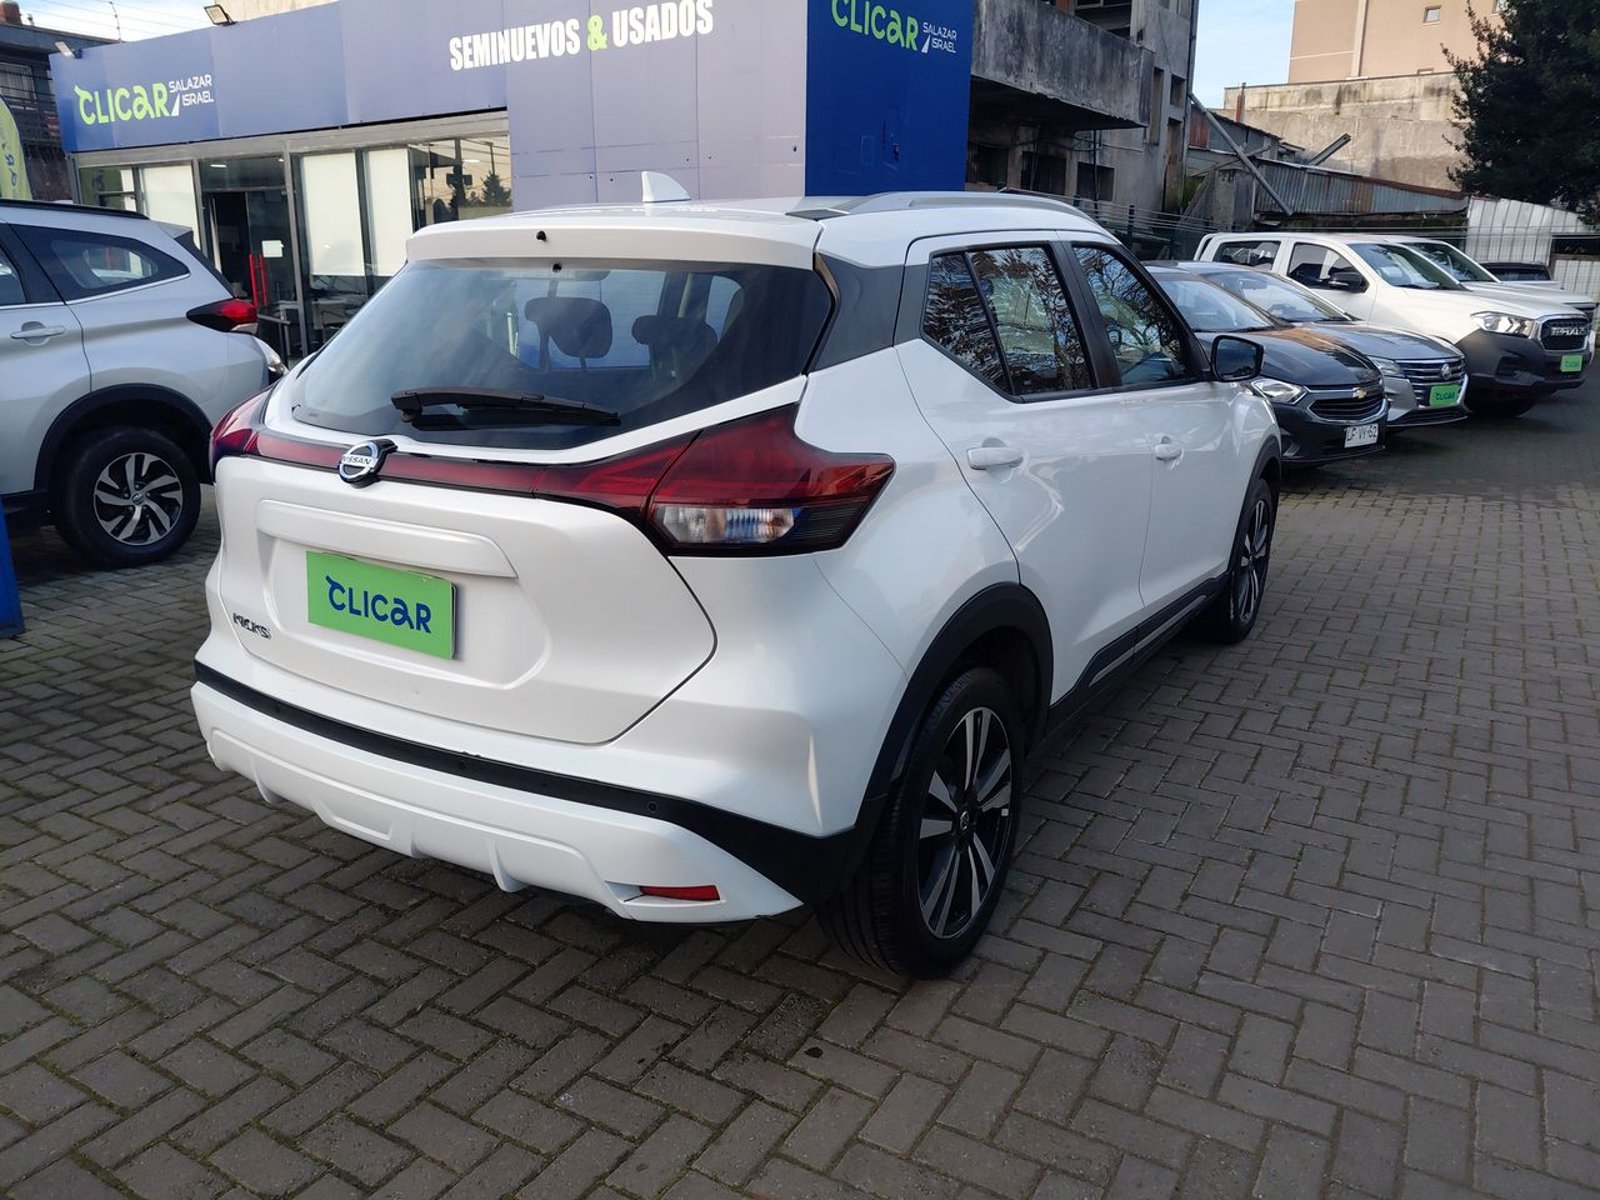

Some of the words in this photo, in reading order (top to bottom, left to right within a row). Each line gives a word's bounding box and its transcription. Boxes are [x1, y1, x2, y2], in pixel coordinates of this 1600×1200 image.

[449, 18, 581, 70] SEMINUEVOS
[586, 15, 608, 50] &
[612, 0, 714, 47] USADOS
[922, 22, 957, 41] SALAZAR
[931, 38, 957, 53] ISRAEL
[168, 74, 212, 93] SALAZAR
[182, 91, 214, 106] ISRAEL
[233, 612, 272, 640] KICKS
